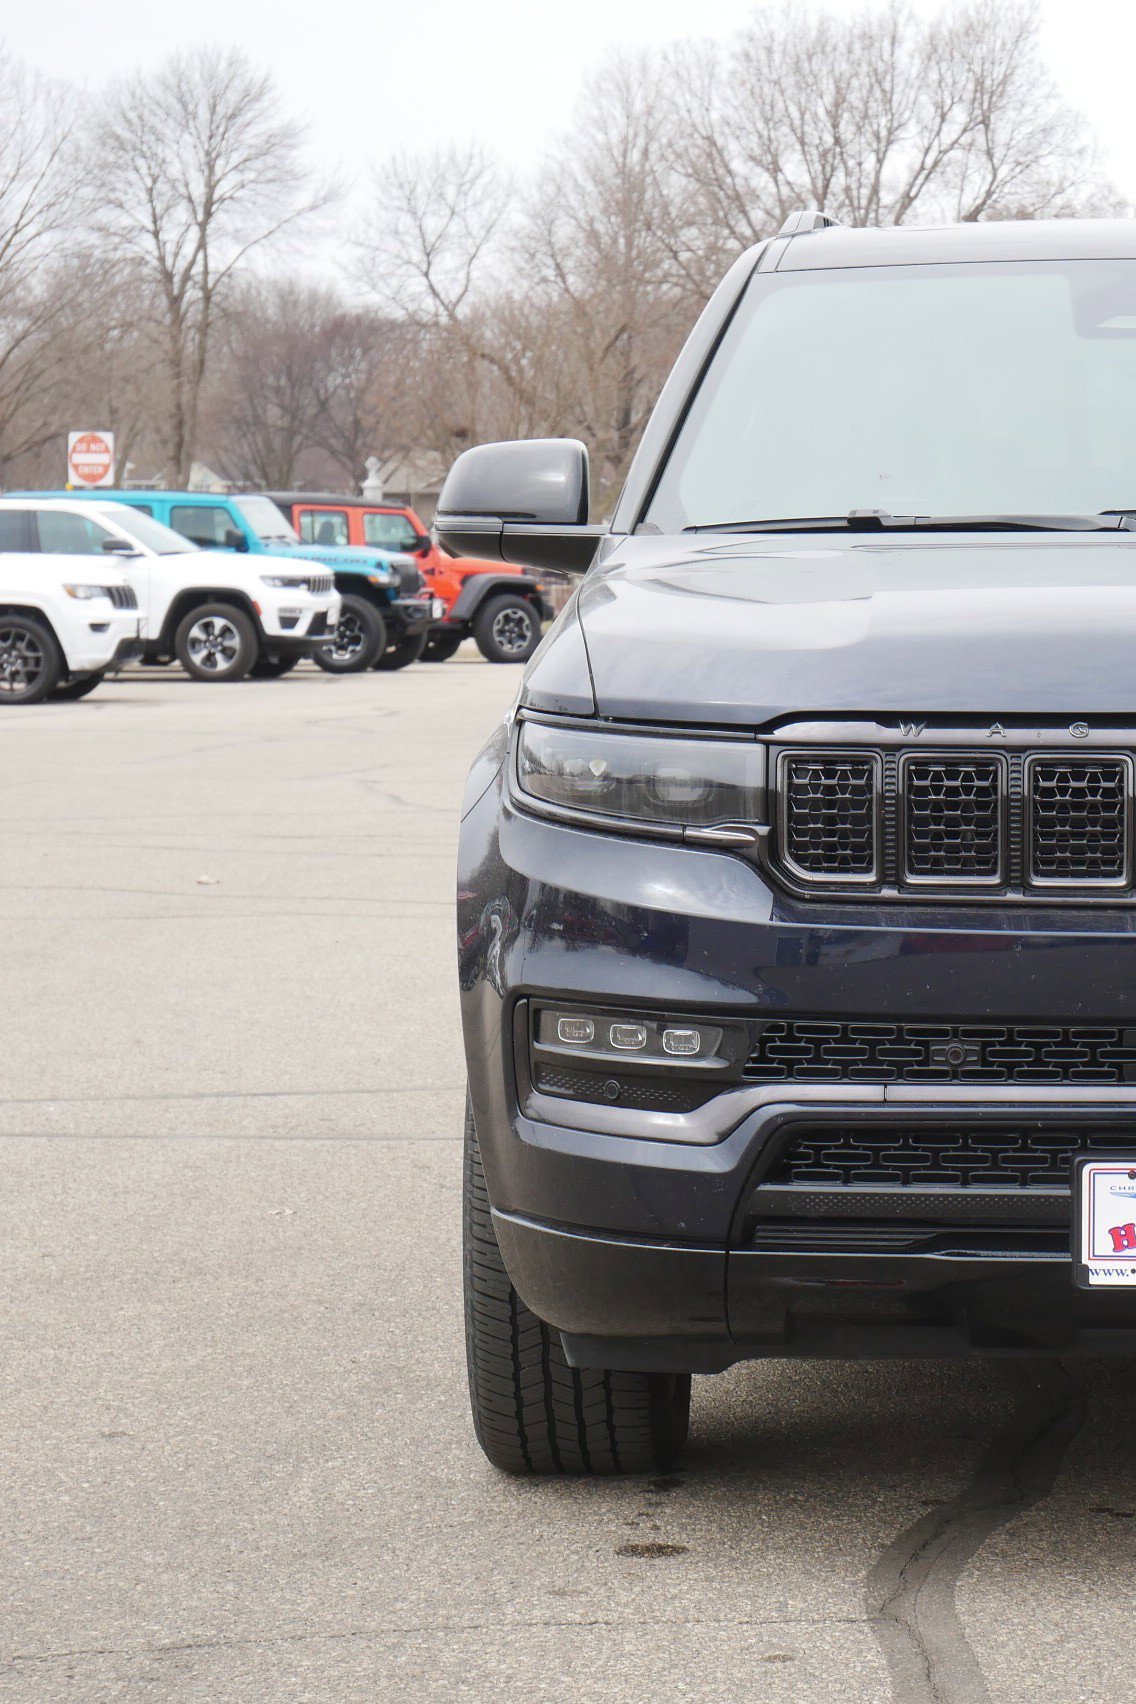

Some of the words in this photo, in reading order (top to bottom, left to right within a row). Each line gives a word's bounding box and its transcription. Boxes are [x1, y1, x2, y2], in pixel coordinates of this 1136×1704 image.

[75, 442, 86, 452] DO
[89, 442, 106, 452] NOT
[78, 465, 104, 475] ENTER
